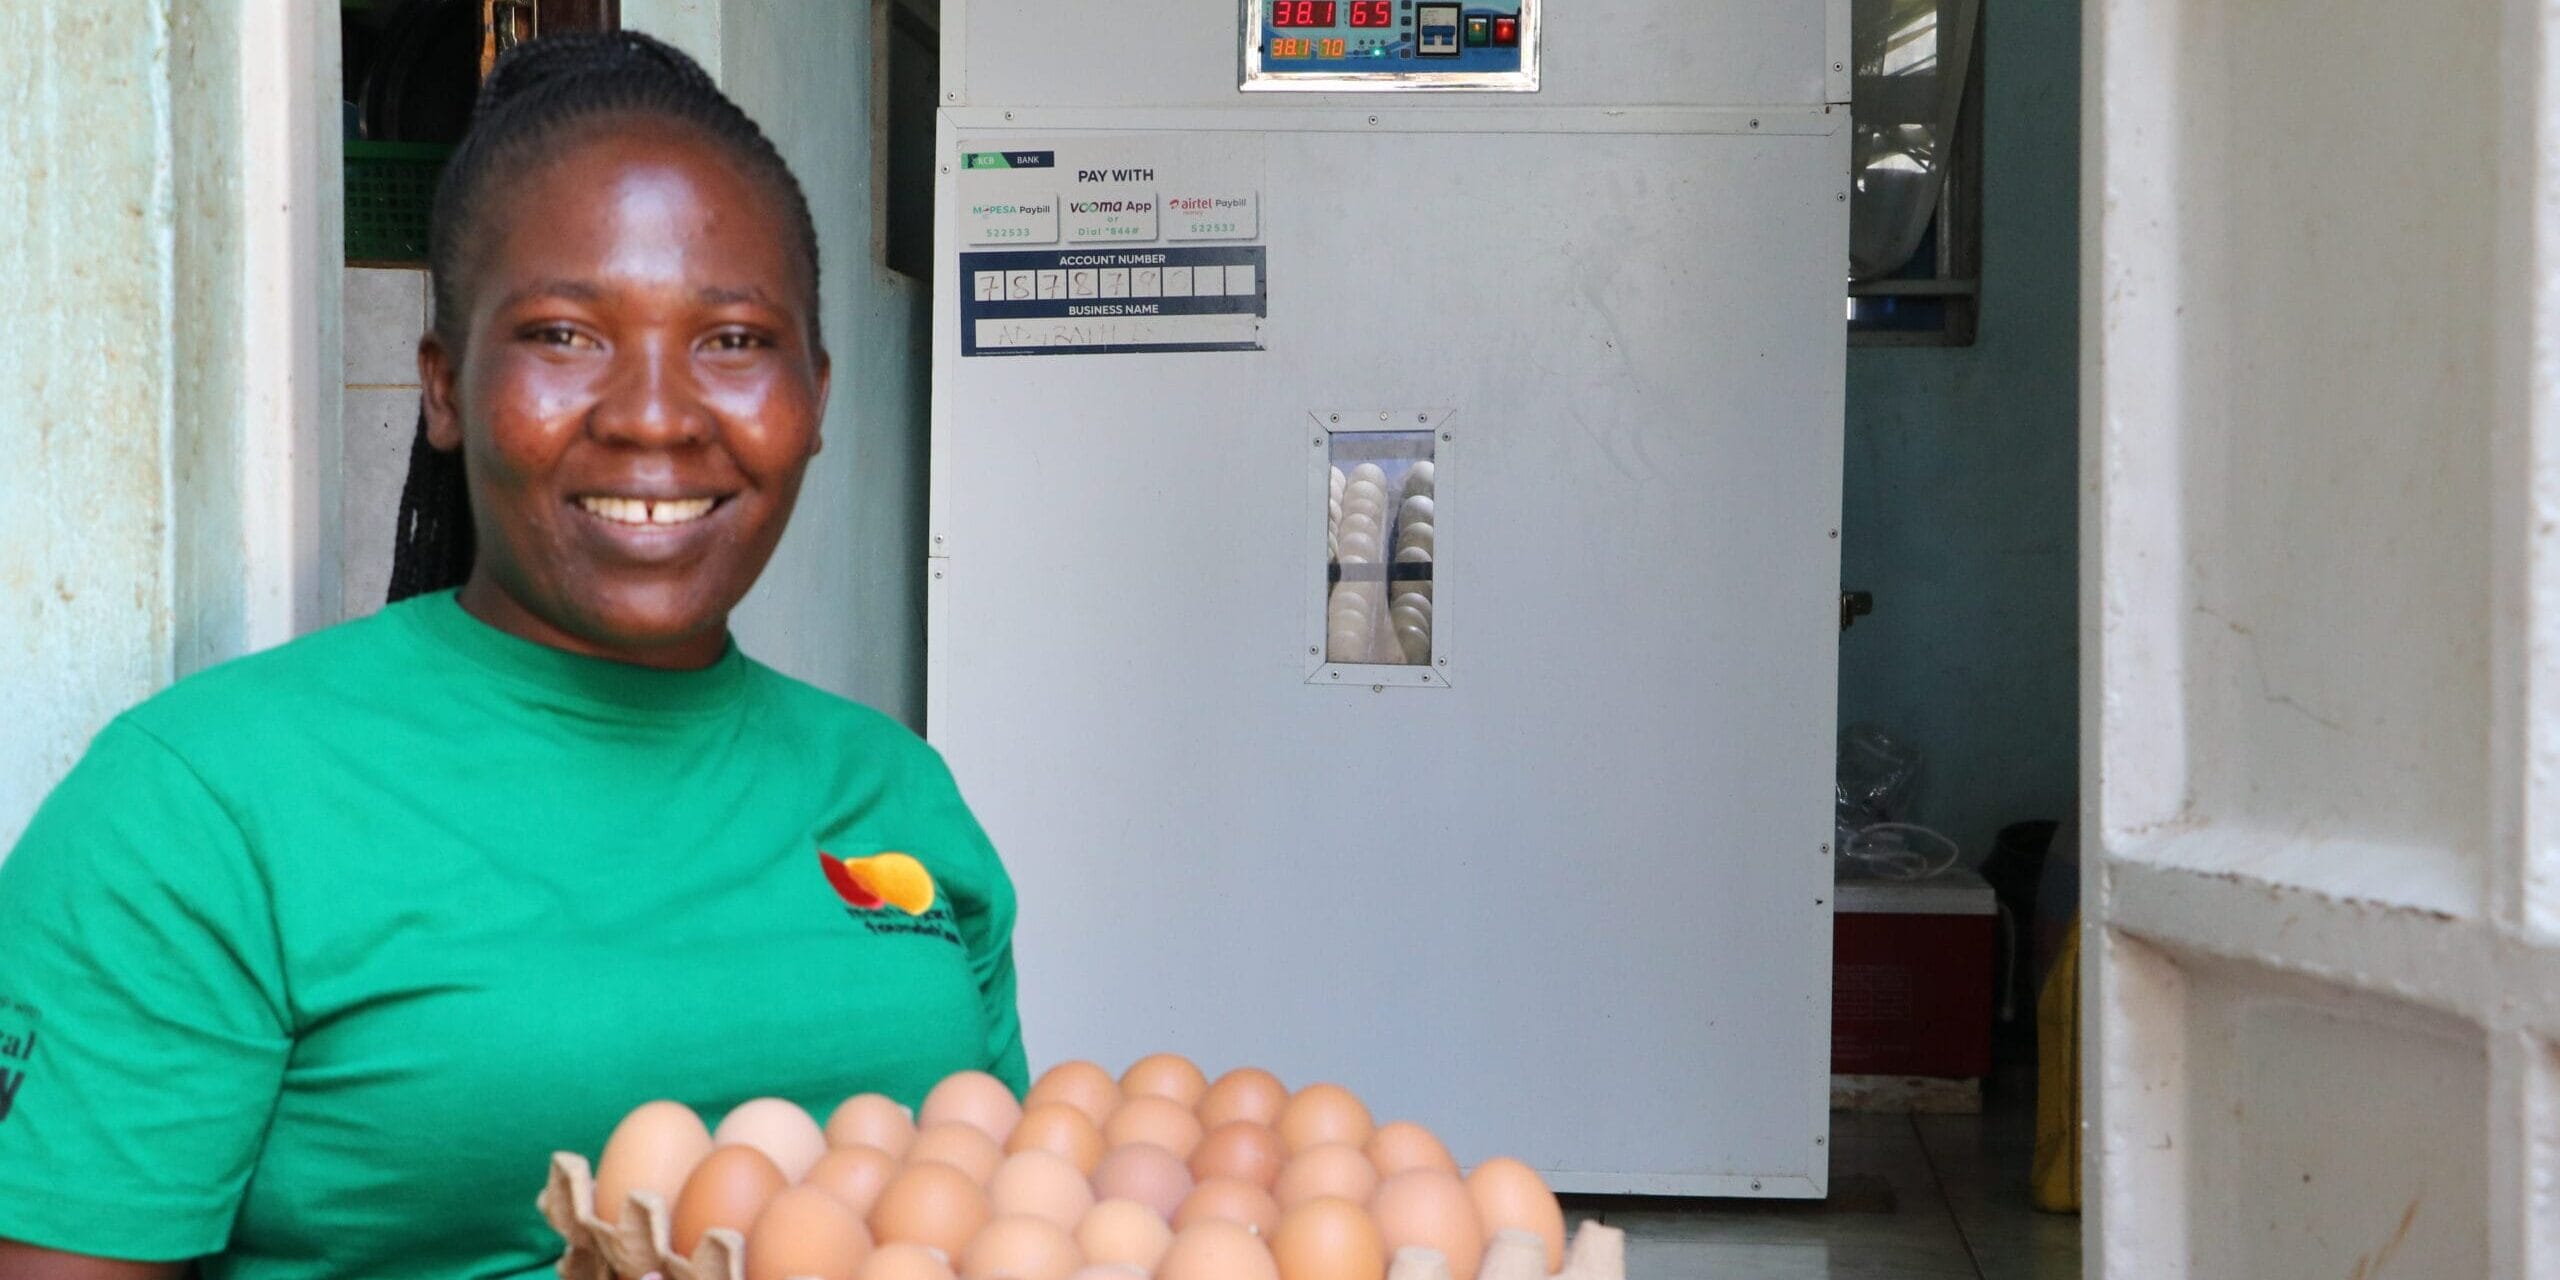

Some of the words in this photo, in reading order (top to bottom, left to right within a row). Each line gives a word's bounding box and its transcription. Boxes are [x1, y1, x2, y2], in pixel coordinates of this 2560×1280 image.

[1276, 1, 1333, 24] 38.1
[1352, 1, 1390, 24] 65
[1272, 39, 1310, 56] 38.1
[1321, 39, 1343, 56] 70
[1016, 156, 1040, 164] BANK
[1078, 169, 1107, 182] PAY
[1112, 169, 1154, 182] WITH
[1126, 201, 1152, 213] App
[1181, 197, 1213, 209] airtel
[1215, 198, 1247, 208] Paybill
[1019, 205, 1050, 215] Paybill
[986, 228, 1030, 237] 522533
[1078, 228, 1101, 236] Dial
[1059, 255, 1116, 266] ACCOUNT
[1118, 254, 1166, 265] NUMBER
[1068, 305, 1123, 316] BUSINESS
[1125, 304, 1159, 315] NAME
